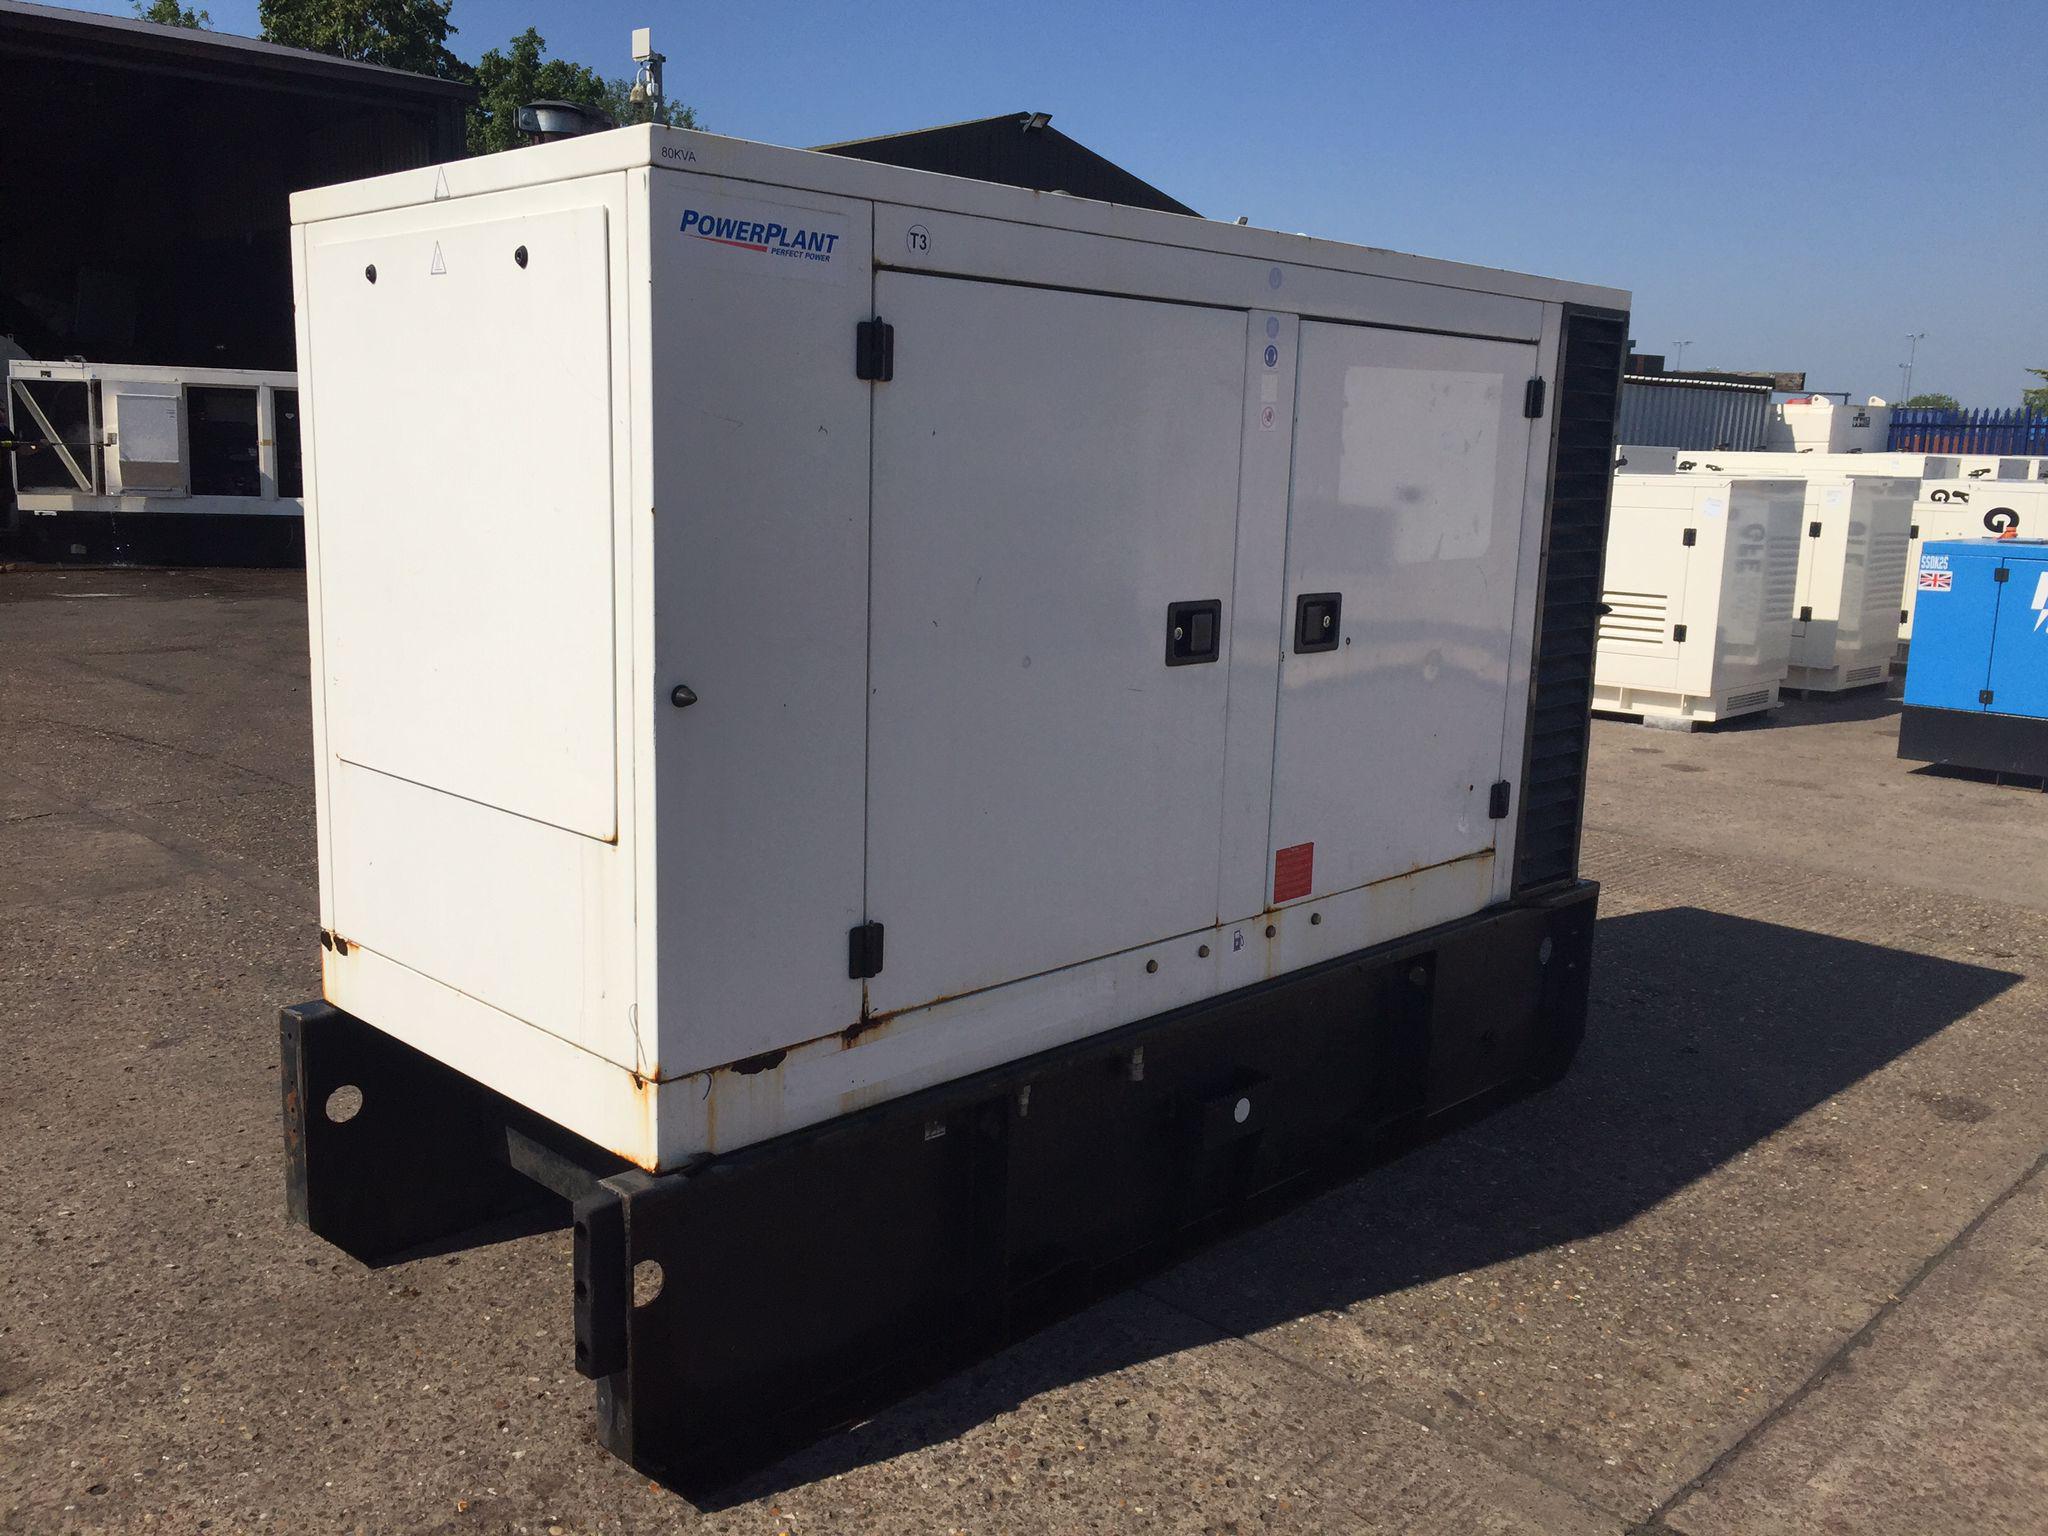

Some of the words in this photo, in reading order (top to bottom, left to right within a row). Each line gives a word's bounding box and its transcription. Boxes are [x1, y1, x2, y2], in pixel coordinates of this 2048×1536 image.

[661, 146, 697, 162] 80KVA
[679, 209, 840, 254] POWERPLANT
[910, 232, 927, 250] T3
[771, 247, 803, 259] PERFECT
[804, 249, 831, 263] POWER
